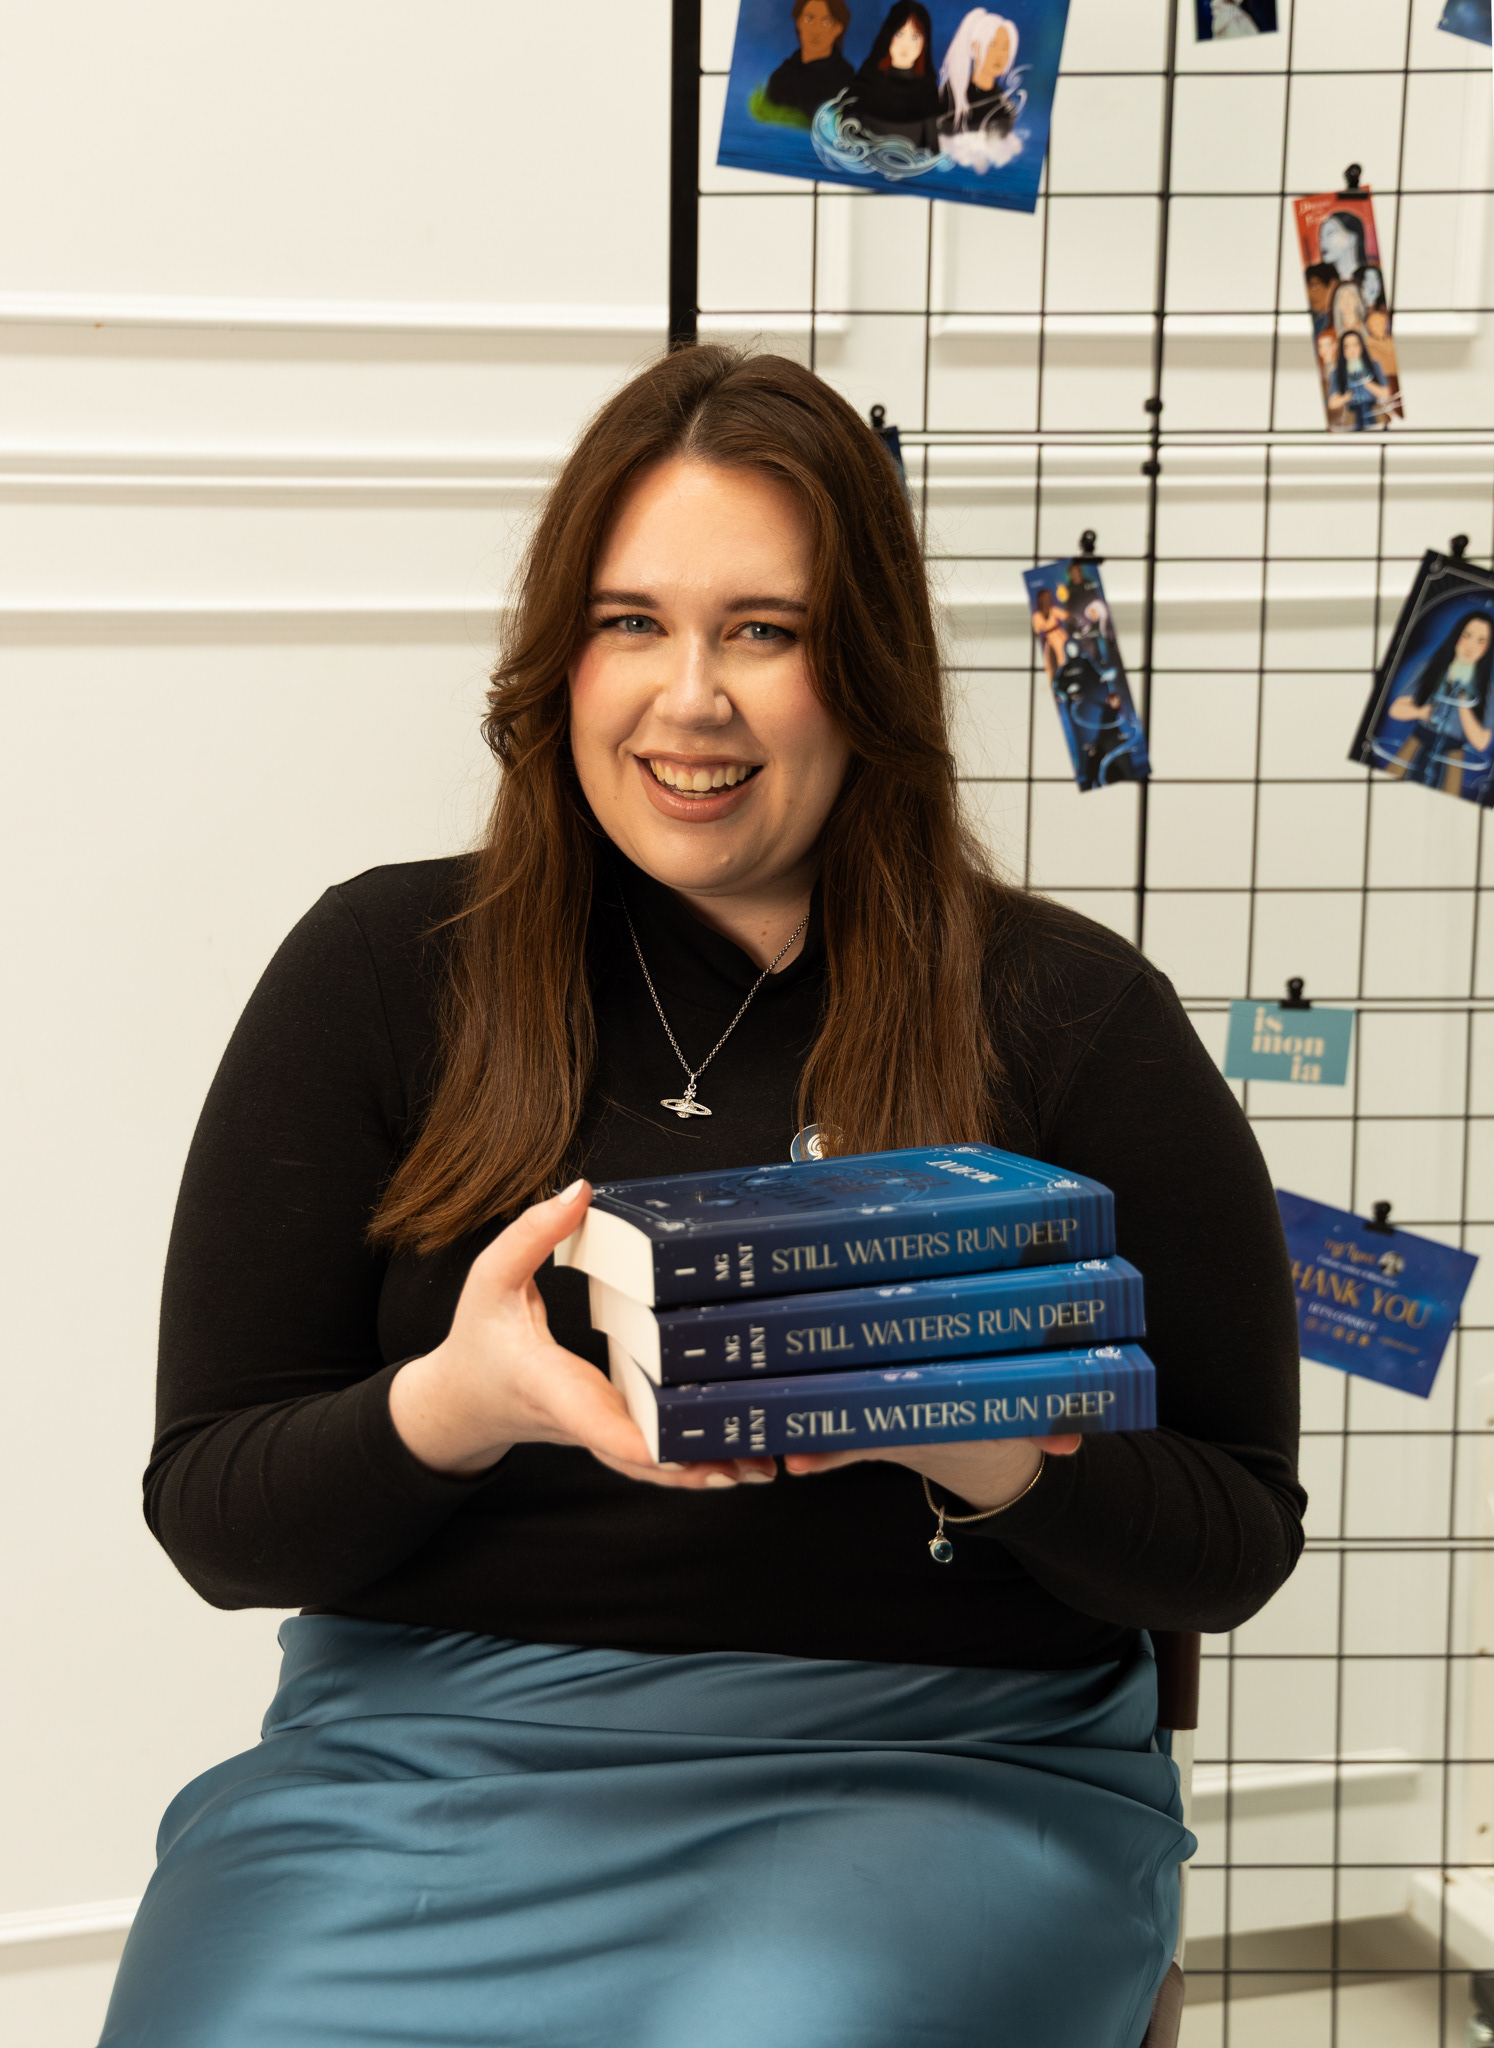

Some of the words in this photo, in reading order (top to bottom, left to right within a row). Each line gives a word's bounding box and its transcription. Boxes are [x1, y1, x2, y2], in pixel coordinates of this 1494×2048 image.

[1254, 1006, 1284, 1033] is
[1251, 1034, 1325, 1058] mon
[1290, 1055, 1322, 1083] ia
[714, 1253, 731, 1281] MG
[737, 1242, 755, 1288] HUNT
[771, 1243, 838, 1274] STILL
[845, 1231, 950, 1265] WATERS
[957, 1225, 1007, 1254] RUN
[1015, 1218, 1078, 1247] DEEP
[1289, 1259, 1366, 1309] HANK
[1372, 1287, 1434, 1330] YOU
[725, 1334, 741, 1363] MG
[749, 1323, 767, 1369] HUNT
[786, 1325, 854, 1354] STILL
[861, 1313, 971, 1347] WATERS
[978, 1306, 1031, 1336] RUN
[1039, 1299, 1105, 1328] DEEP
[724, 1416, 740, 1444] MG
[749, 1406, 767, 1451] HUNT
[786, 1409, 856, 1437] STILL
[863, 1400, 976, 1431] WATERS
[984, 1395, 1038, 1424] RUN
[1046, 1390, 1115, 1418] DEEP
